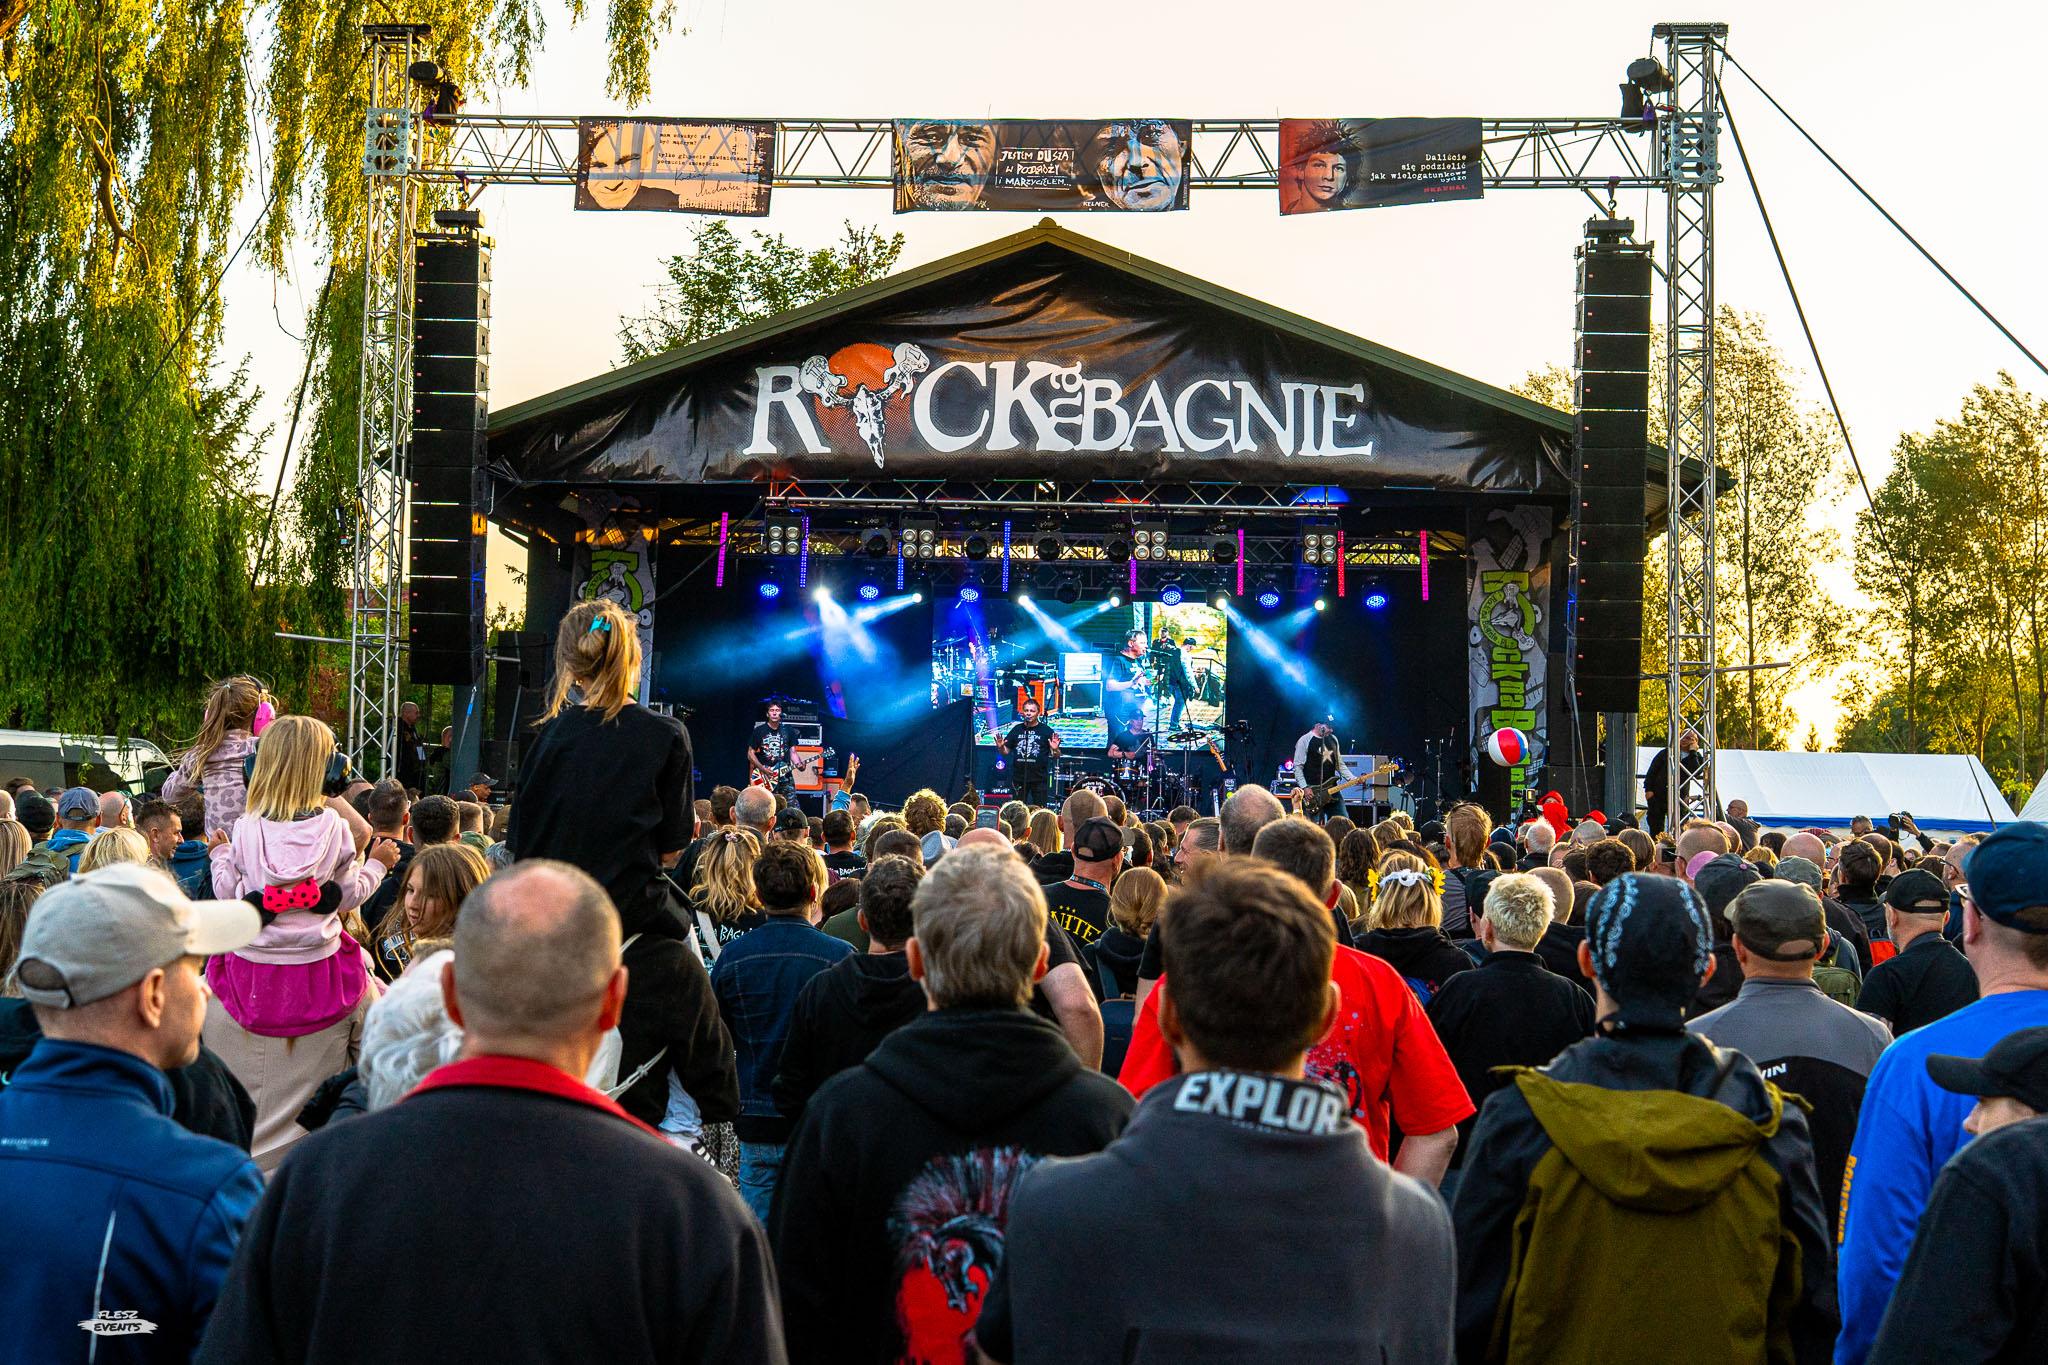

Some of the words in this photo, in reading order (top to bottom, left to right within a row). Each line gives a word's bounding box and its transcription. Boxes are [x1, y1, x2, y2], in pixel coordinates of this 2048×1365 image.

[1000, 150, 1033, 162] JESTEM
[1370, 172, 1386, 182] jak
[1074, 378, 1373, 457] BAGNIE
